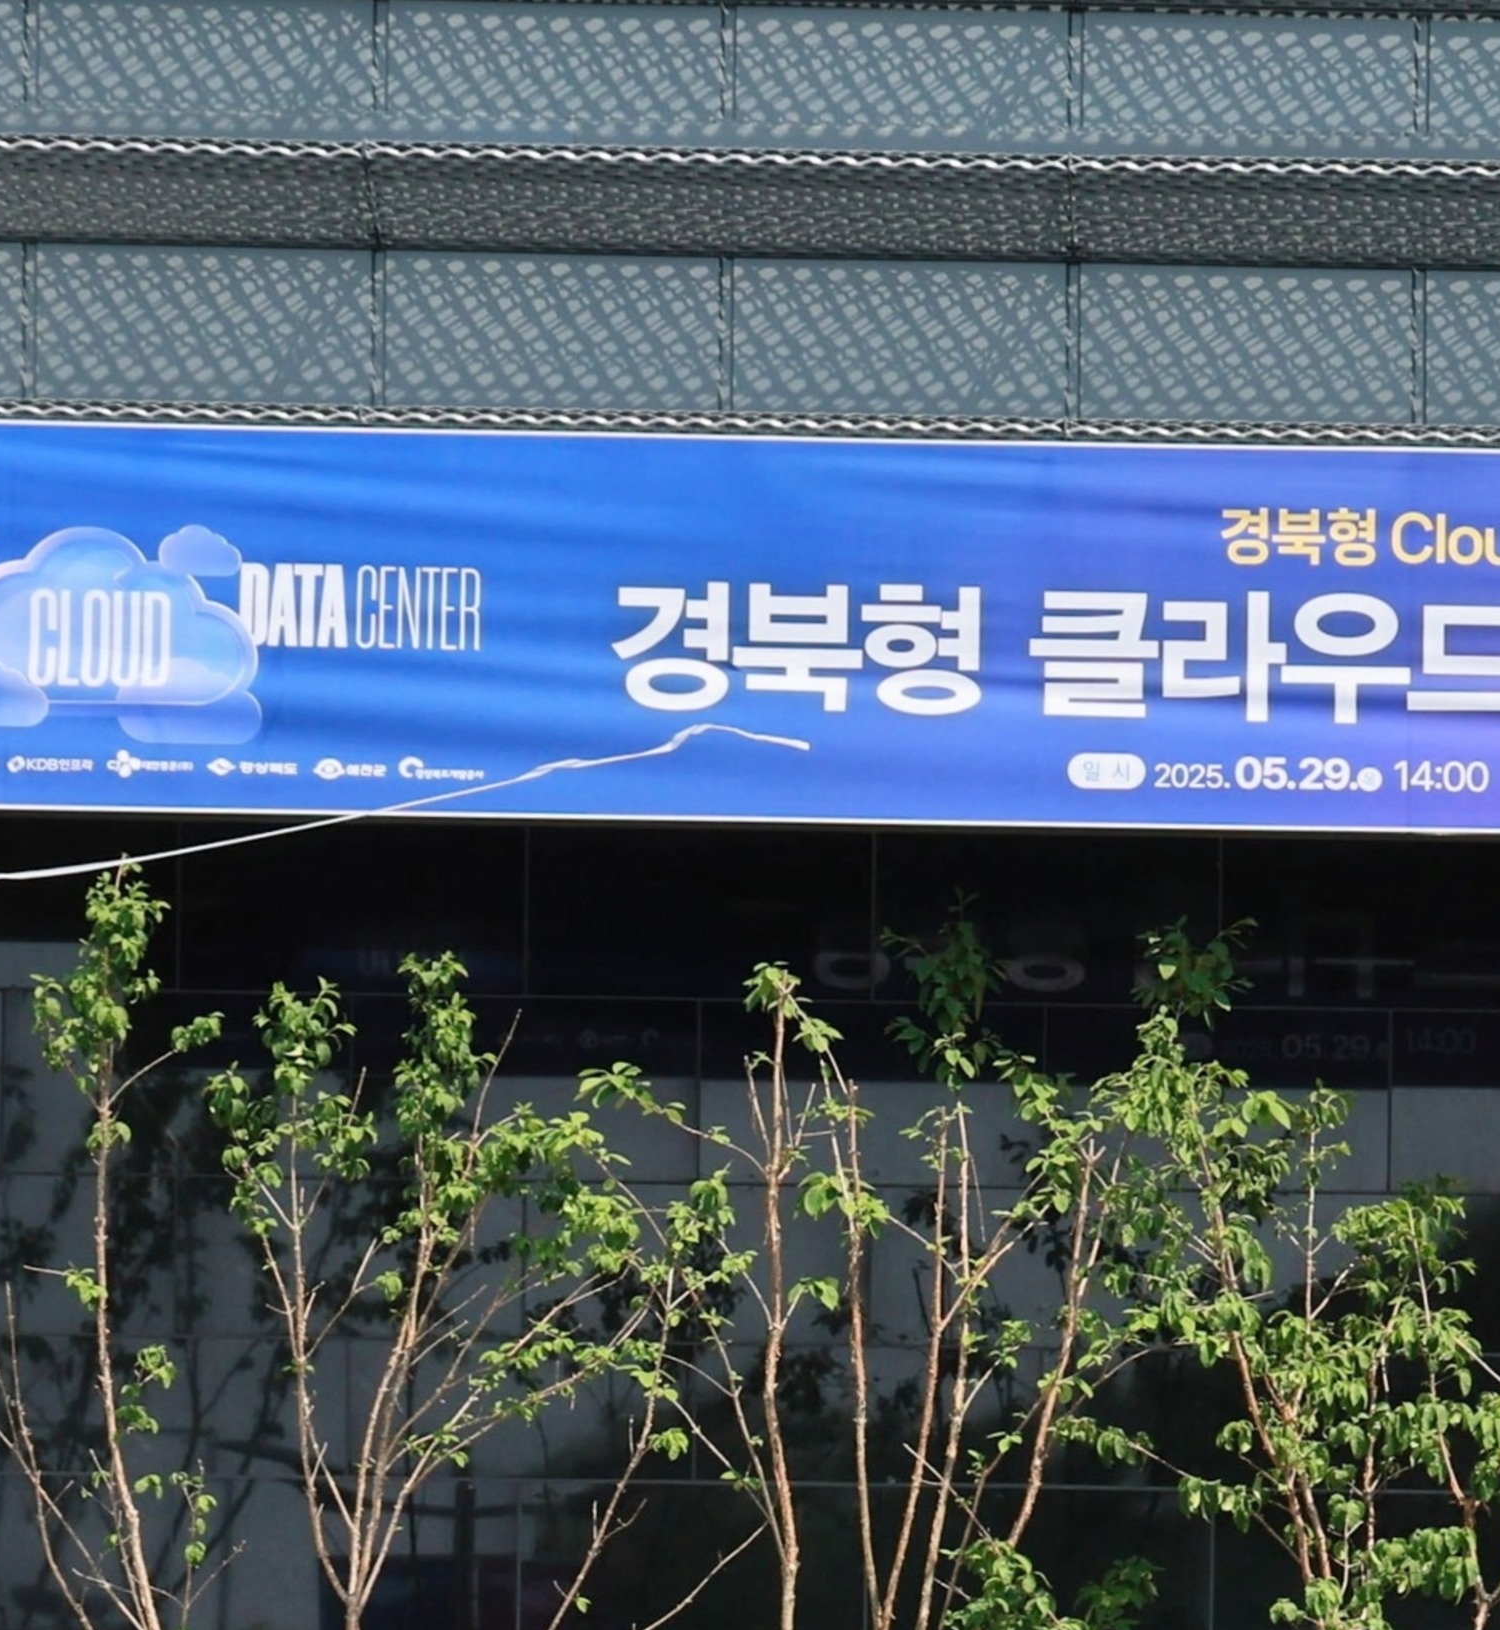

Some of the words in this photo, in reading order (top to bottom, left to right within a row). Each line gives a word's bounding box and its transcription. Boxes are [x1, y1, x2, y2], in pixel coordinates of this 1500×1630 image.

[1221, 508, 1376, 566] 경북형
[27, 587, 174, 689] CLOUD
[239, 562, 348, 648] DATA
[355, 565, 480, 651] CENTER
[612, 582, 982, 715] 경북형
[1155, 763, 1230, 788] 2025.
[1394, 761, 1489, 792] 14:00
